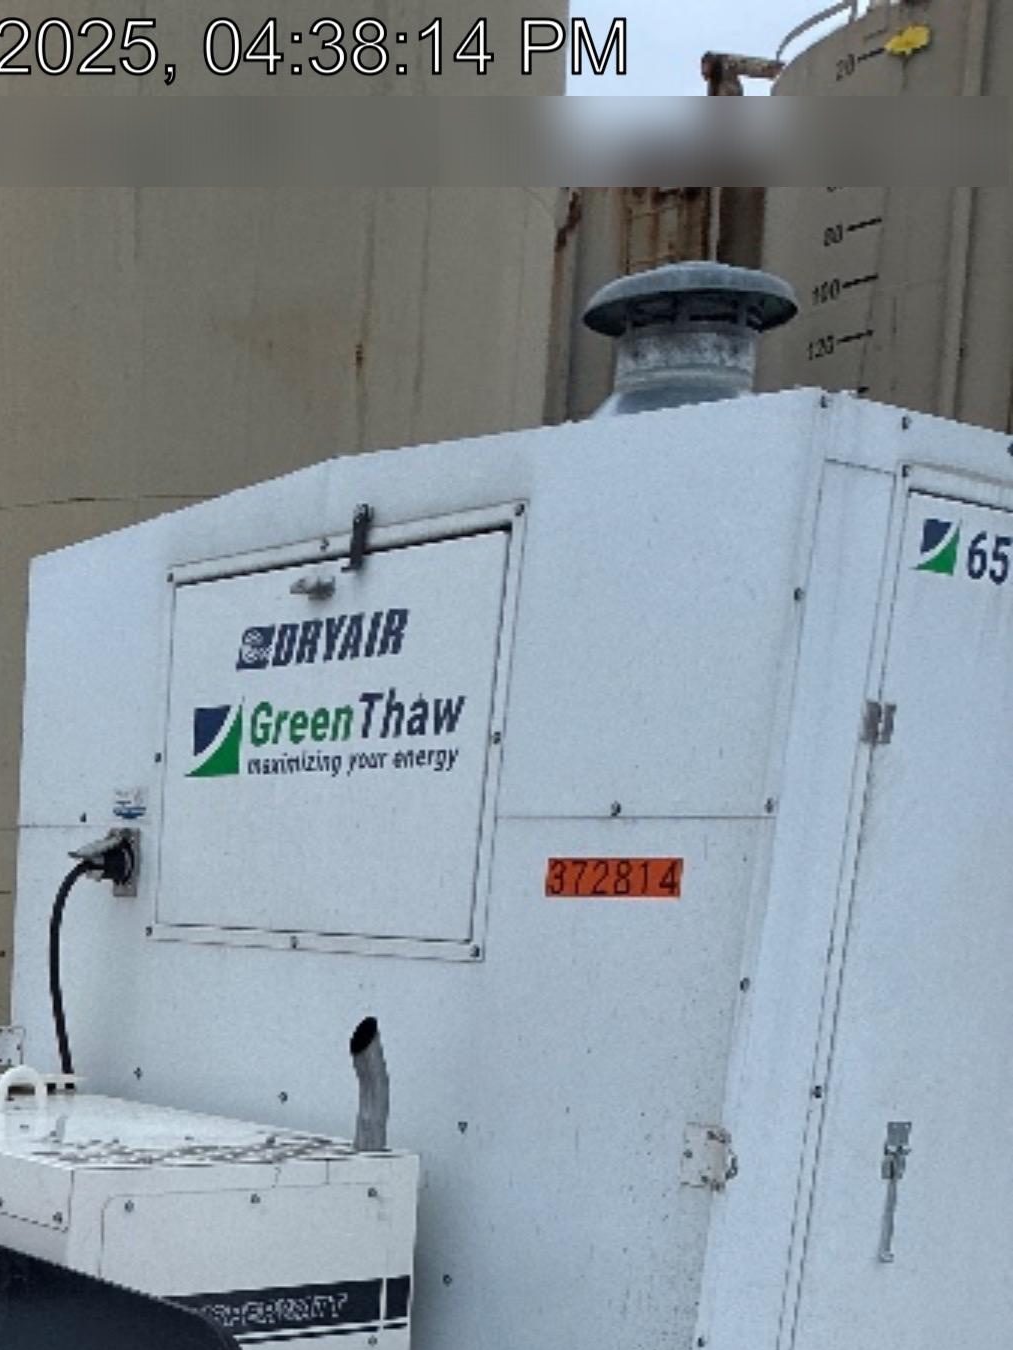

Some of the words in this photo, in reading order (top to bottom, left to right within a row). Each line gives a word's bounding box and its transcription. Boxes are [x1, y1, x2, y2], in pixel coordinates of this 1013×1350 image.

[808, 335, 834, 360] 120
[272, 608, 409, 667] DRYAIR
[247, 749, 342, 777] maximizing
[347, 752, 387, 777] your
[393, 748, 459, 772] energy
[547, 860, 678, 895] 372814
